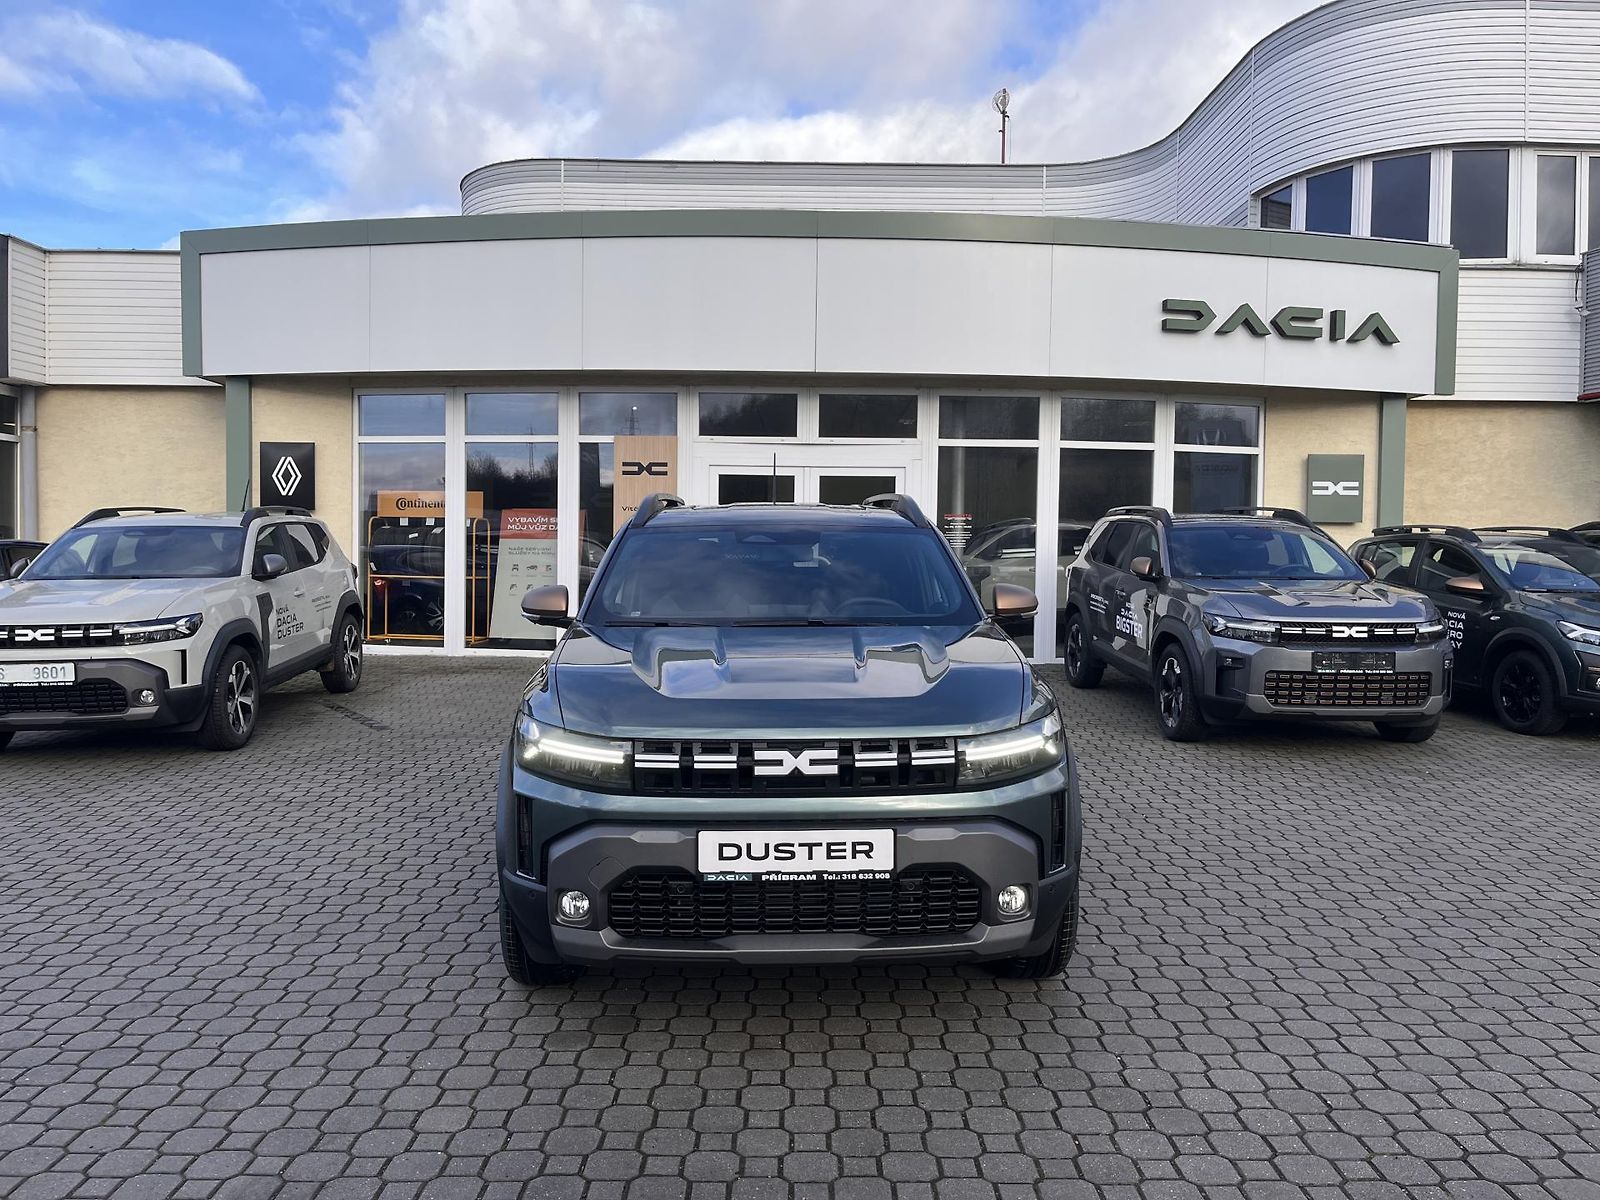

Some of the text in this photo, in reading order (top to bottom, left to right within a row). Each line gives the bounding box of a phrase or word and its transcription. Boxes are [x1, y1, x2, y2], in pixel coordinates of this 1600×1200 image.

[1161, 298, 1401, 346] DACIA
[395, 497, 446, 511] Continent
[276, 613, 298, 628] DACIA
[1447, 611, 1466, 620] NOVÁ
[277, 621, 304, 639] DUSTER
[1115, 615, 1143, 639] BIGSTER
[33, 666, 66, 680] 9601
[717, 841, 874, 861] DUSTER
[761, 873, 817, 881] PŘÍBRAM
